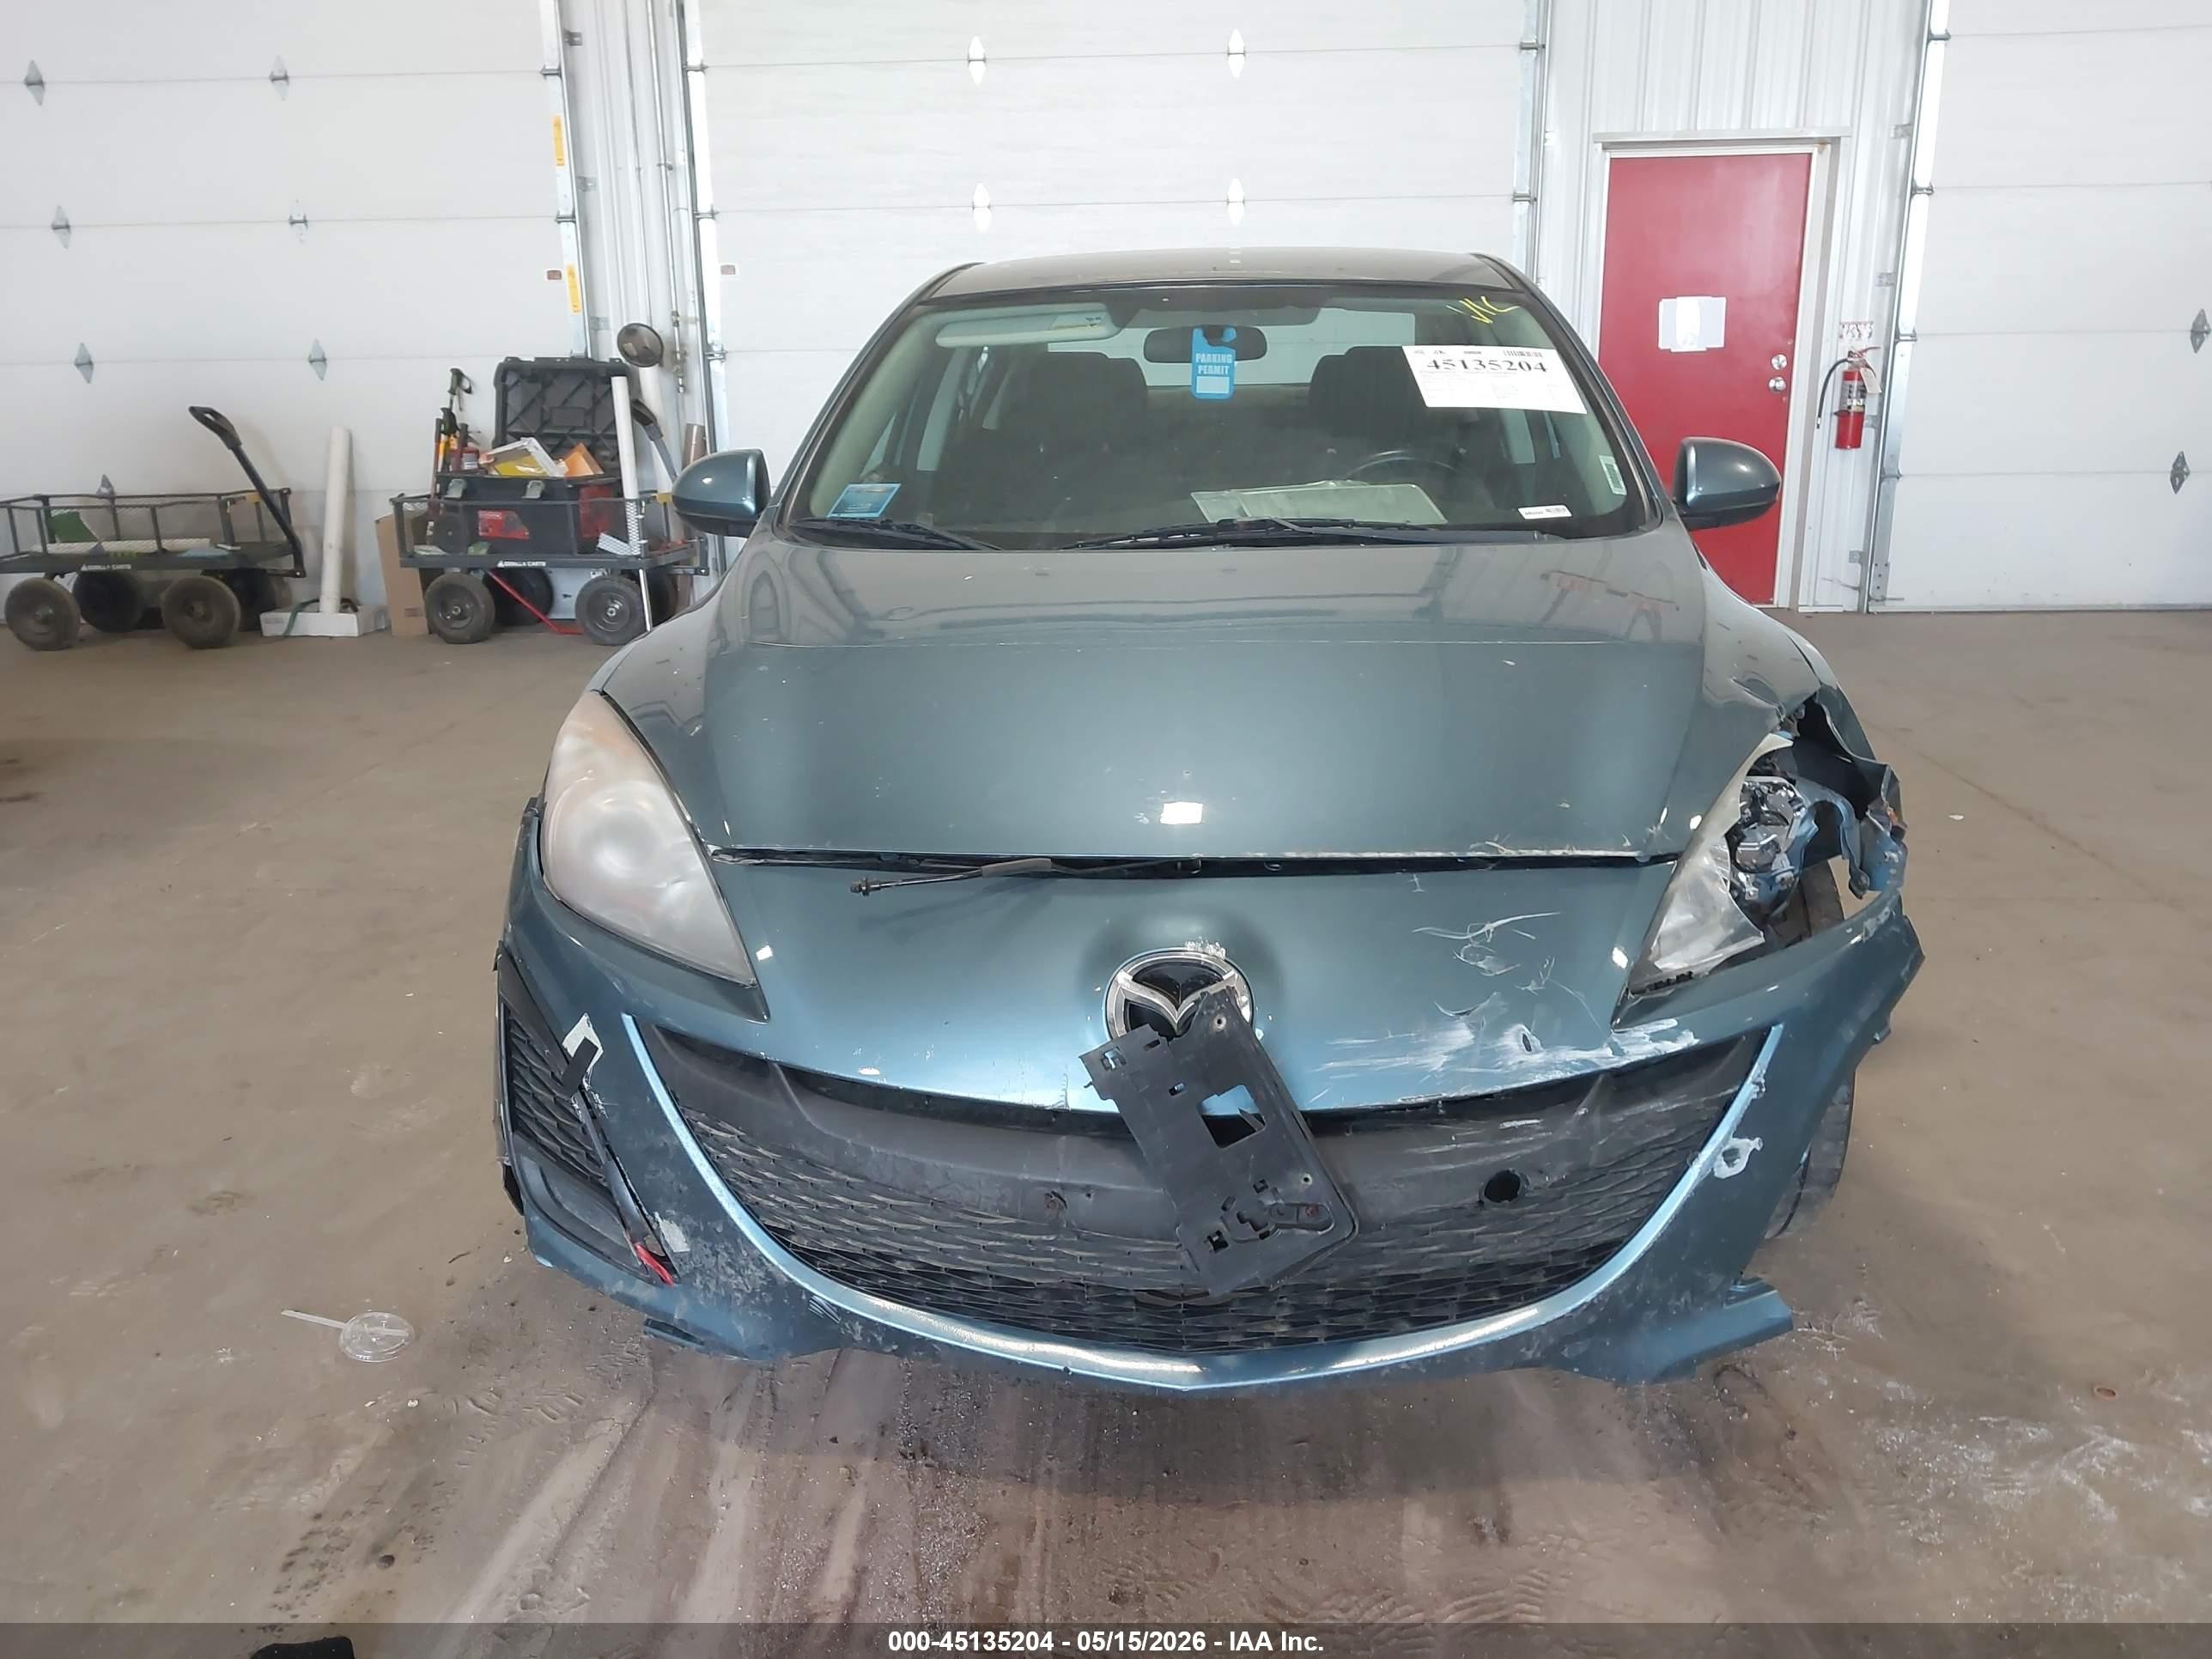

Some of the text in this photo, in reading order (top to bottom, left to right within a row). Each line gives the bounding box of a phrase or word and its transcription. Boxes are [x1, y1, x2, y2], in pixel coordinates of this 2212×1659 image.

[1195, 353, 1233, 364] PARKING
[1198, 365, 1230, 375] PERMIT
[1427, 359, 1549, 373] 45135204
